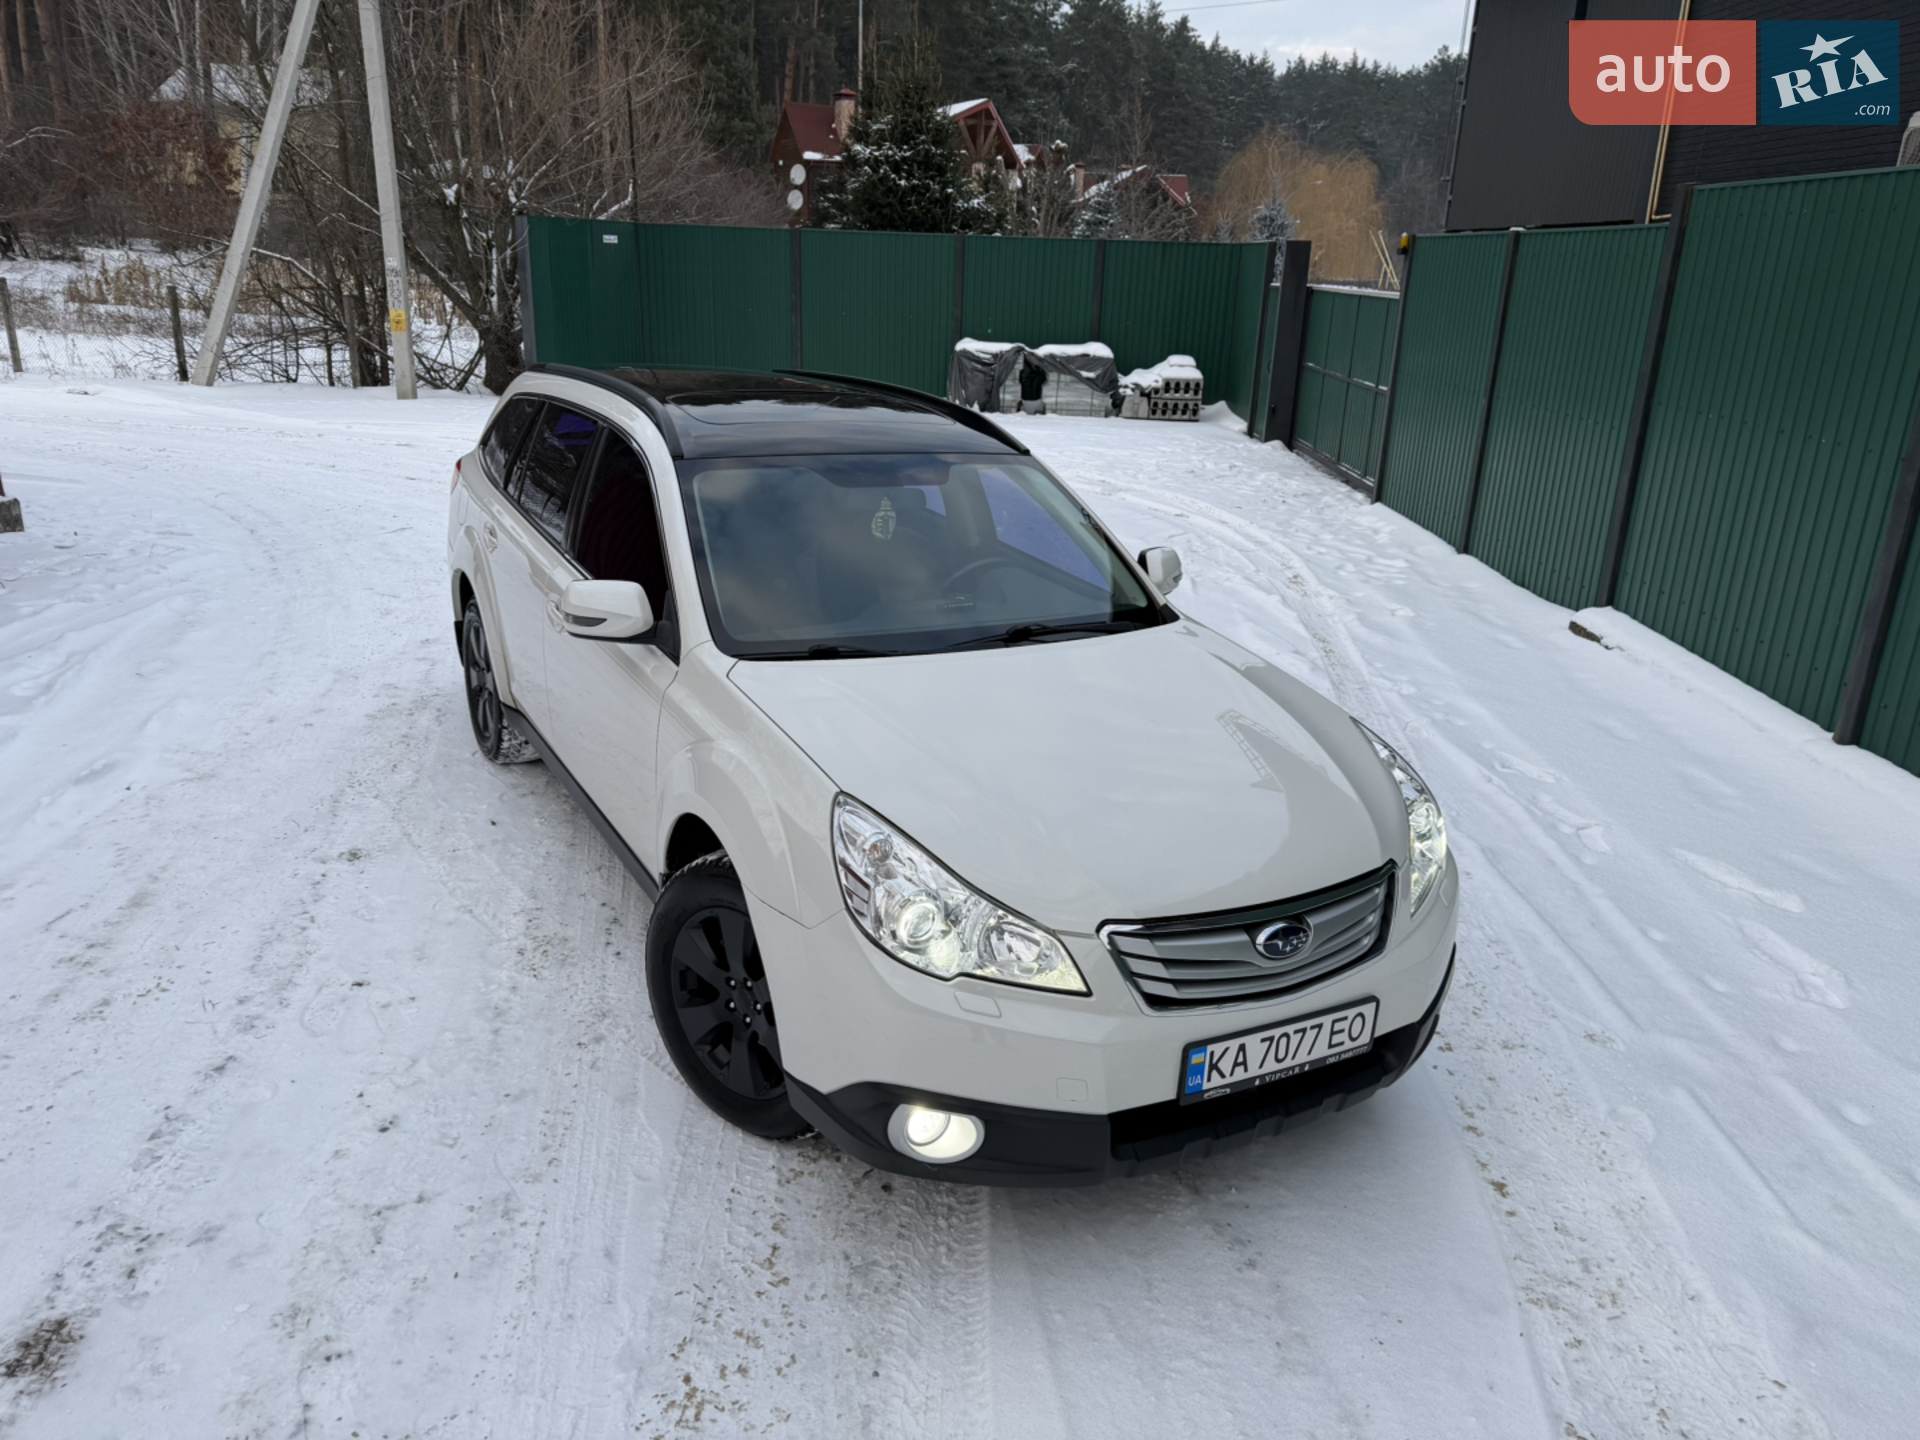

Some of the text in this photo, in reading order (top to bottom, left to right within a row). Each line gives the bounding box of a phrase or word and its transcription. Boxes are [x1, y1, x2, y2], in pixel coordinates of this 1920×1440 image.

[1206, 1012, 1366, 1083] KA 7077 EO
[1188, 1075, 1202, 1086] UA
